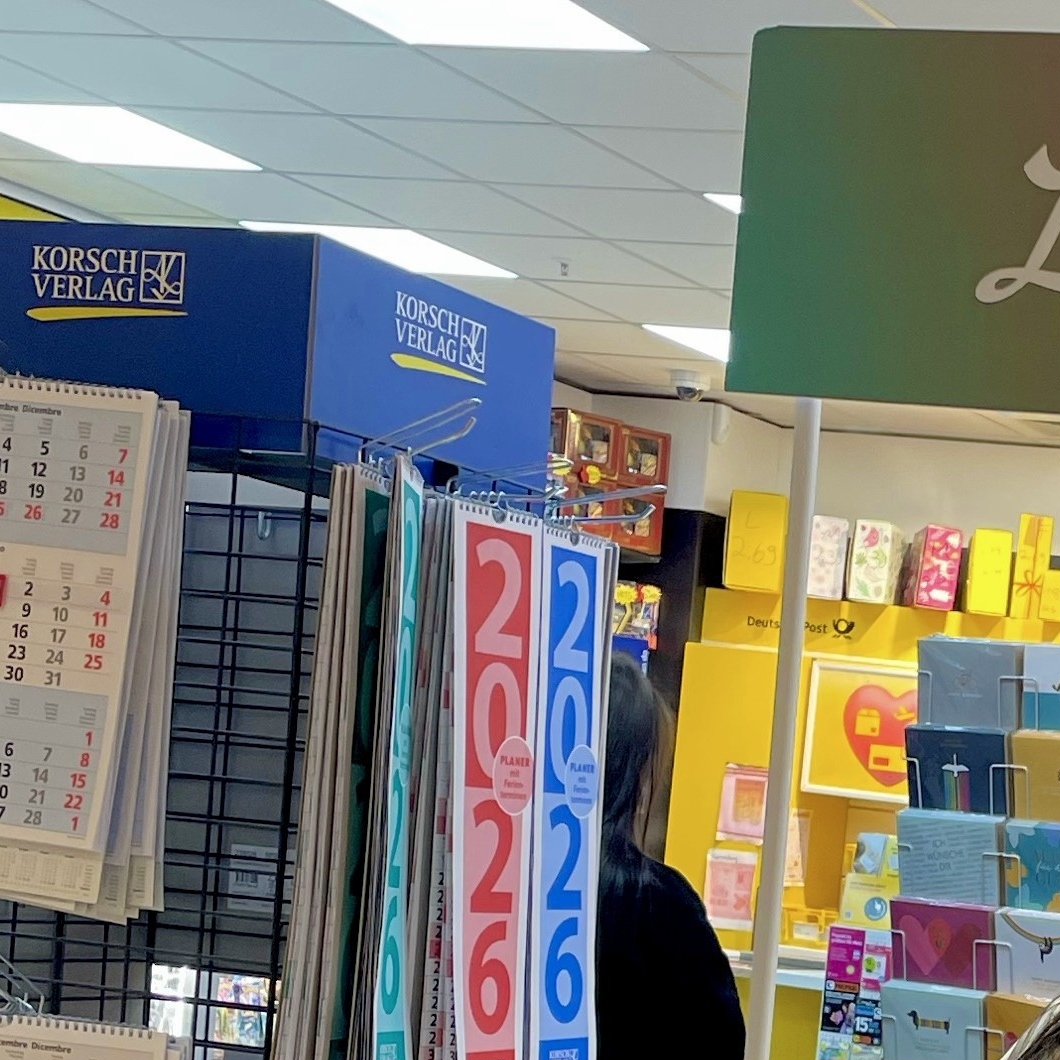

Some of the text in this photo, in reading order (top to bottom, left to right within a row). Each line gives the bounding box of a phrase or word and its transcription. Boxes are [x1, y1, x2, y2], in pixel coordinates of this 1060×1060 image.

[32, 245, 138, 275] KORSCH
[31, 274, 135, 302] VERLAG
[395, 290, 460, 338] KORSCH
[396, 318, 457, 363] VERLAG
[24, 582, 110, 605] 2 3 4
[22, 603, 107, 627] 9 10 11
[747, 616, 780, 629] Deuts
[12, 624, 105, 648] 16 17 18
[8, 645, 103, 669] 23 24 25
[4, 666, 61, 686] 30 31
[500, 755, 530, 767] PLANER
[32, 1042, 71, 1053] Dicembre
